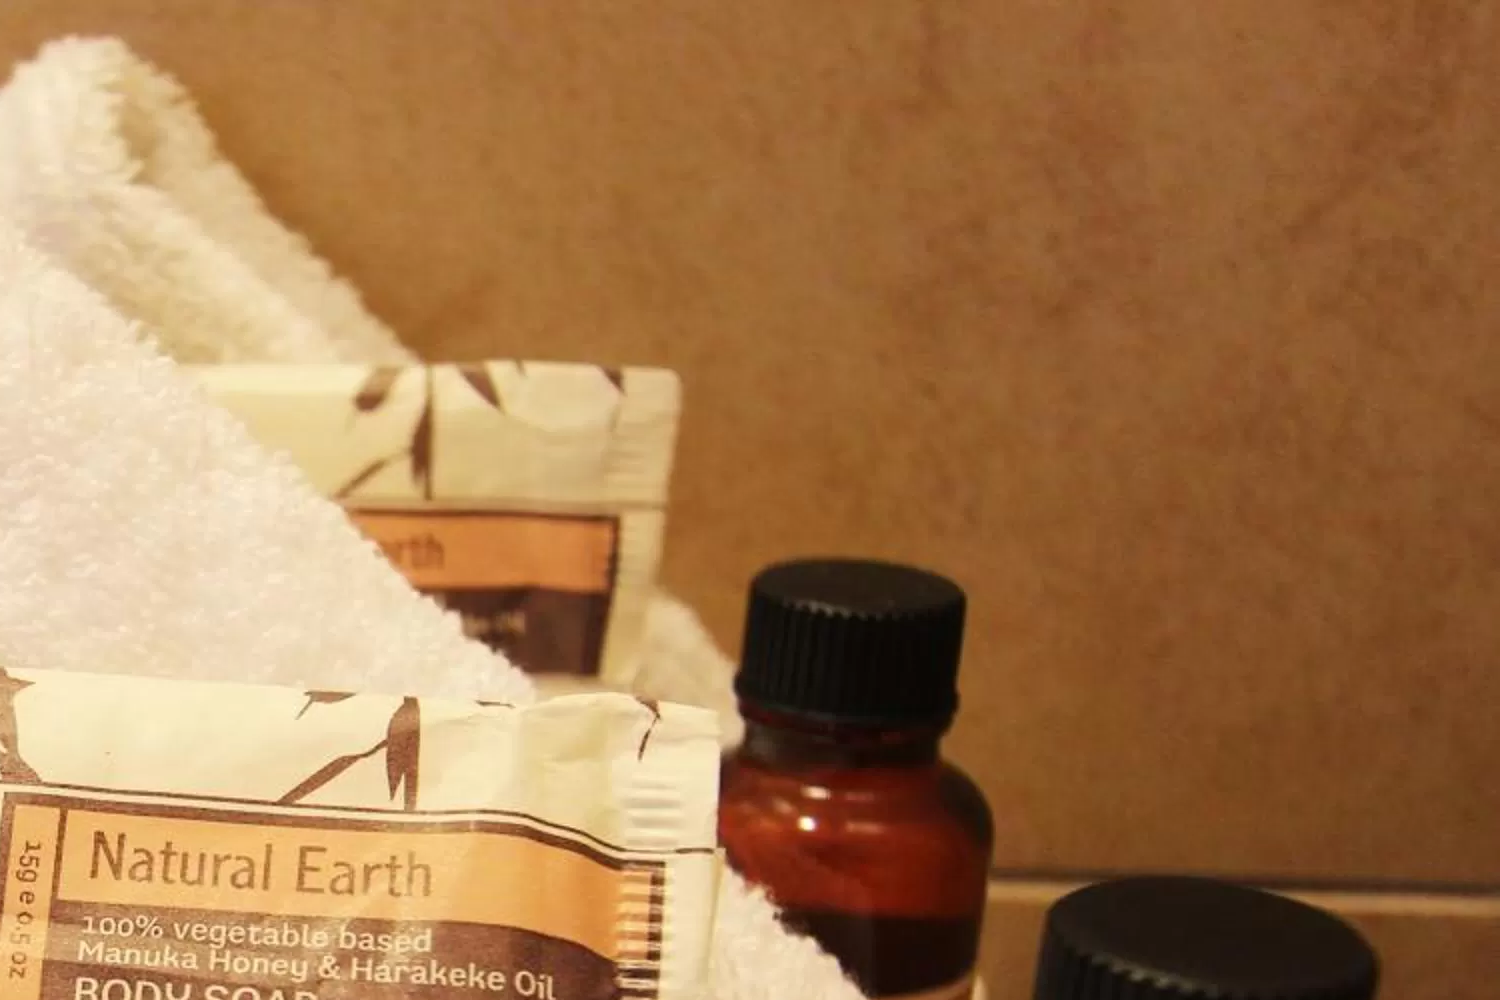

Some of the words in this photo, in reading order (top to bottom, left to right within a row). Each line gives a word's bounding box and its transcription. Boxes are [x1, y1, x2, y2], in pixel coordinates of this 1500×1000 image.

[15, 840, 41, 883] 15g
[89, 829, 273, 892] Natural
[295, 845, 433, 898] Earth
[19, 890, 35, 905] e
[81, 914, 164, 940] 100%
[173, 919, 329, 950] vegetable
[339, 923, 432, 953] based
[8, 951, 27, 979] oz
[77, 940, 198, 971] Manuka
[208, 950, 308, 983] Honey
[318, 955, 341, 980] &
[350, 957, 506, 991] Harakeke
